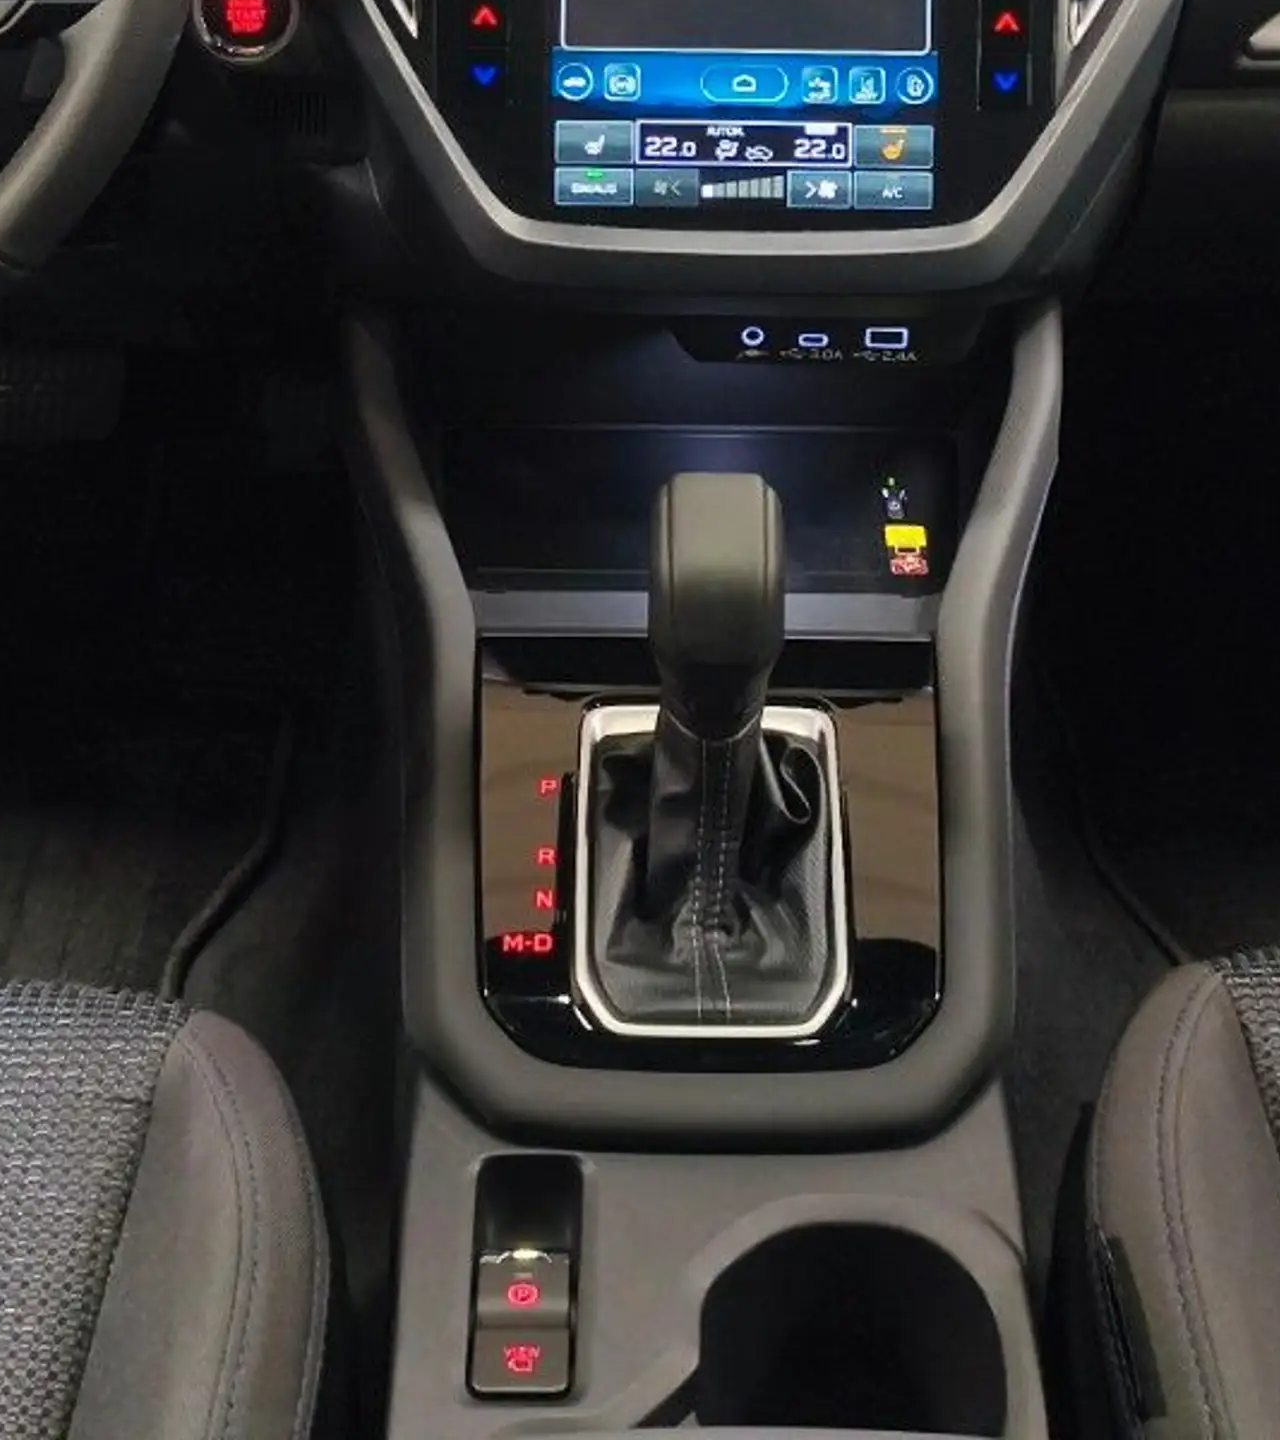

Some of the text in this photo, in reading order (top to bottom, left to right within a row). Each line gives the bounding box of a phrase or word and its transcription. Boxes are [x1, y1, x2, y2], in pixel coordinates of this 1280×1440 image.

[645, 137, 697, 157] 22.0
[793, 138, 846, 159] 22.0
[540, 779, 557, 794] P
[538, 849, 555, 864] R
[536, 891, 553, 908] N
[502, 934, 553, 952] M-D
